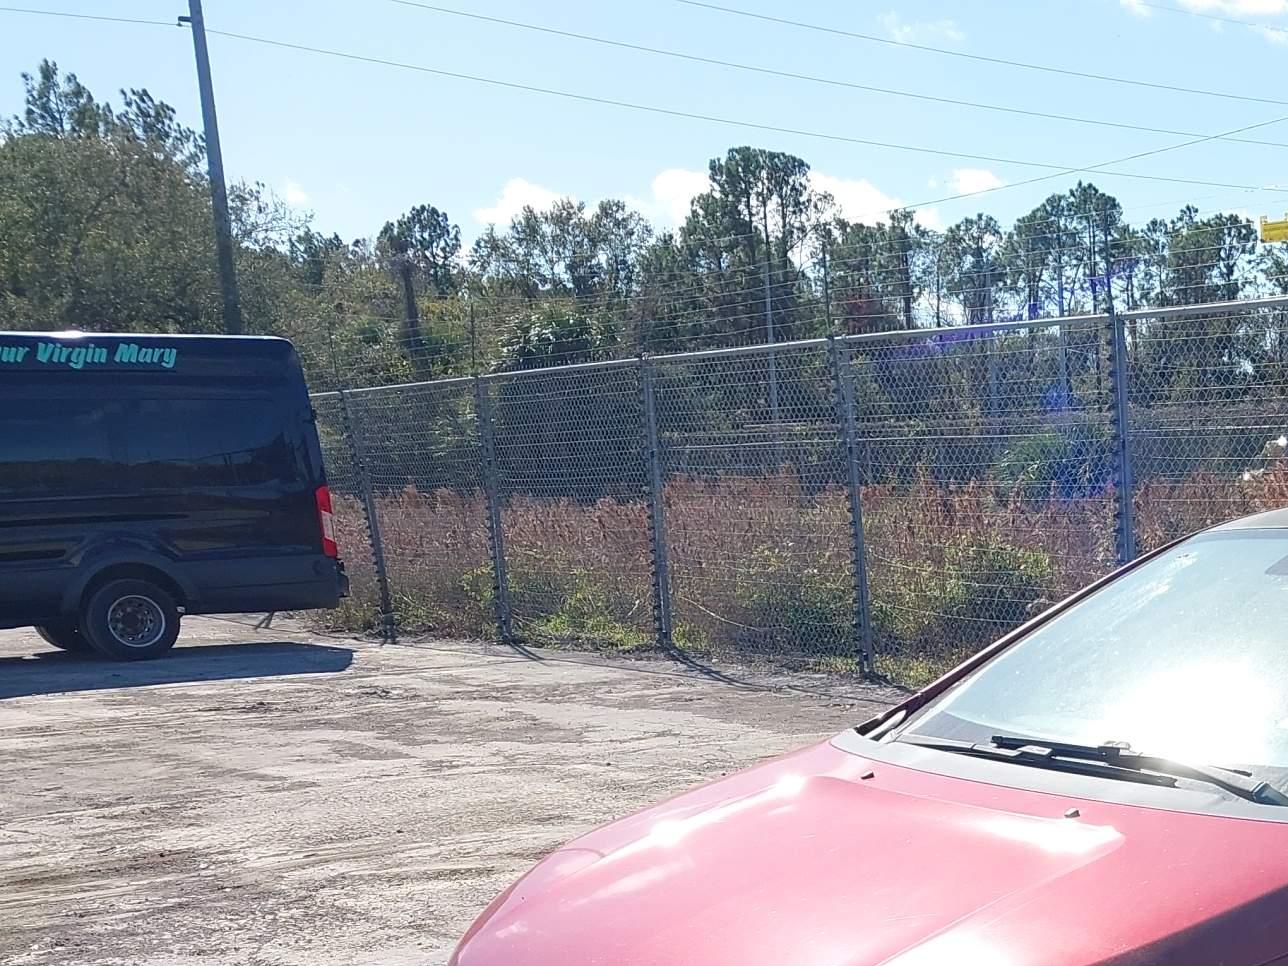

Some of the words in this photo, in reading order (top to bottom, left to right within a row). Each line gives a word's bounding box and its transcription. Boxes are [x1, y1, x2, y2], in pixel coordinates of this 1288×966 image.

[0, 346, 30, 363] ur
[36, 342, 108, 369] Virgin
[113, 343, 177, 368] Mary
